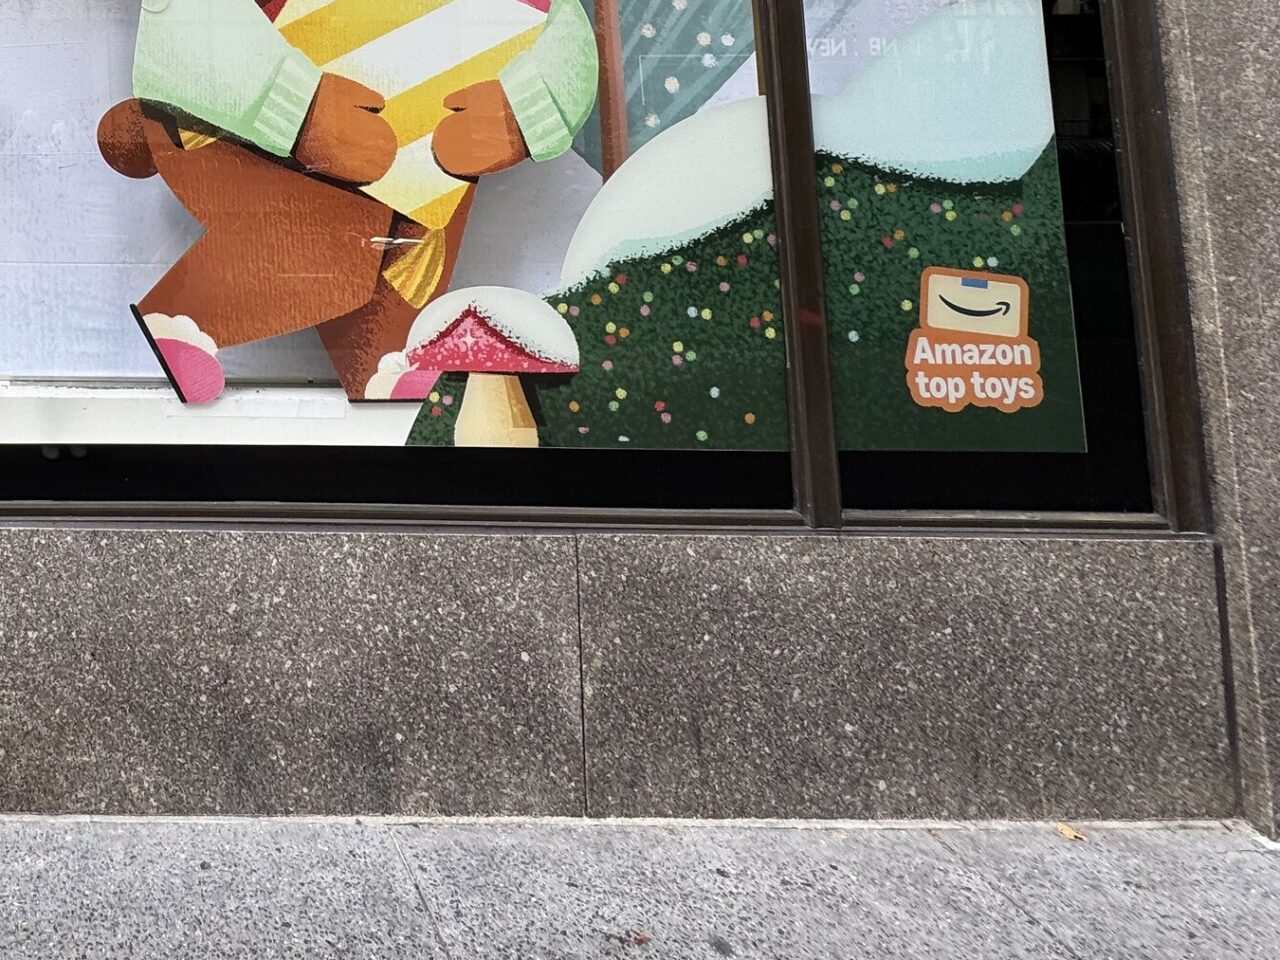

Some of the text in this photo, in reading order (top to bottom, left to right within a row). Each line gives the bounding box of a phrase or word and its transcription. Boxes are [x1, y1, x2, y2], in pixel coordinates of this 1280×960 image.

[913, 336, 1033, 366] Amazon
[915, 371, 1036, 405] top toys
